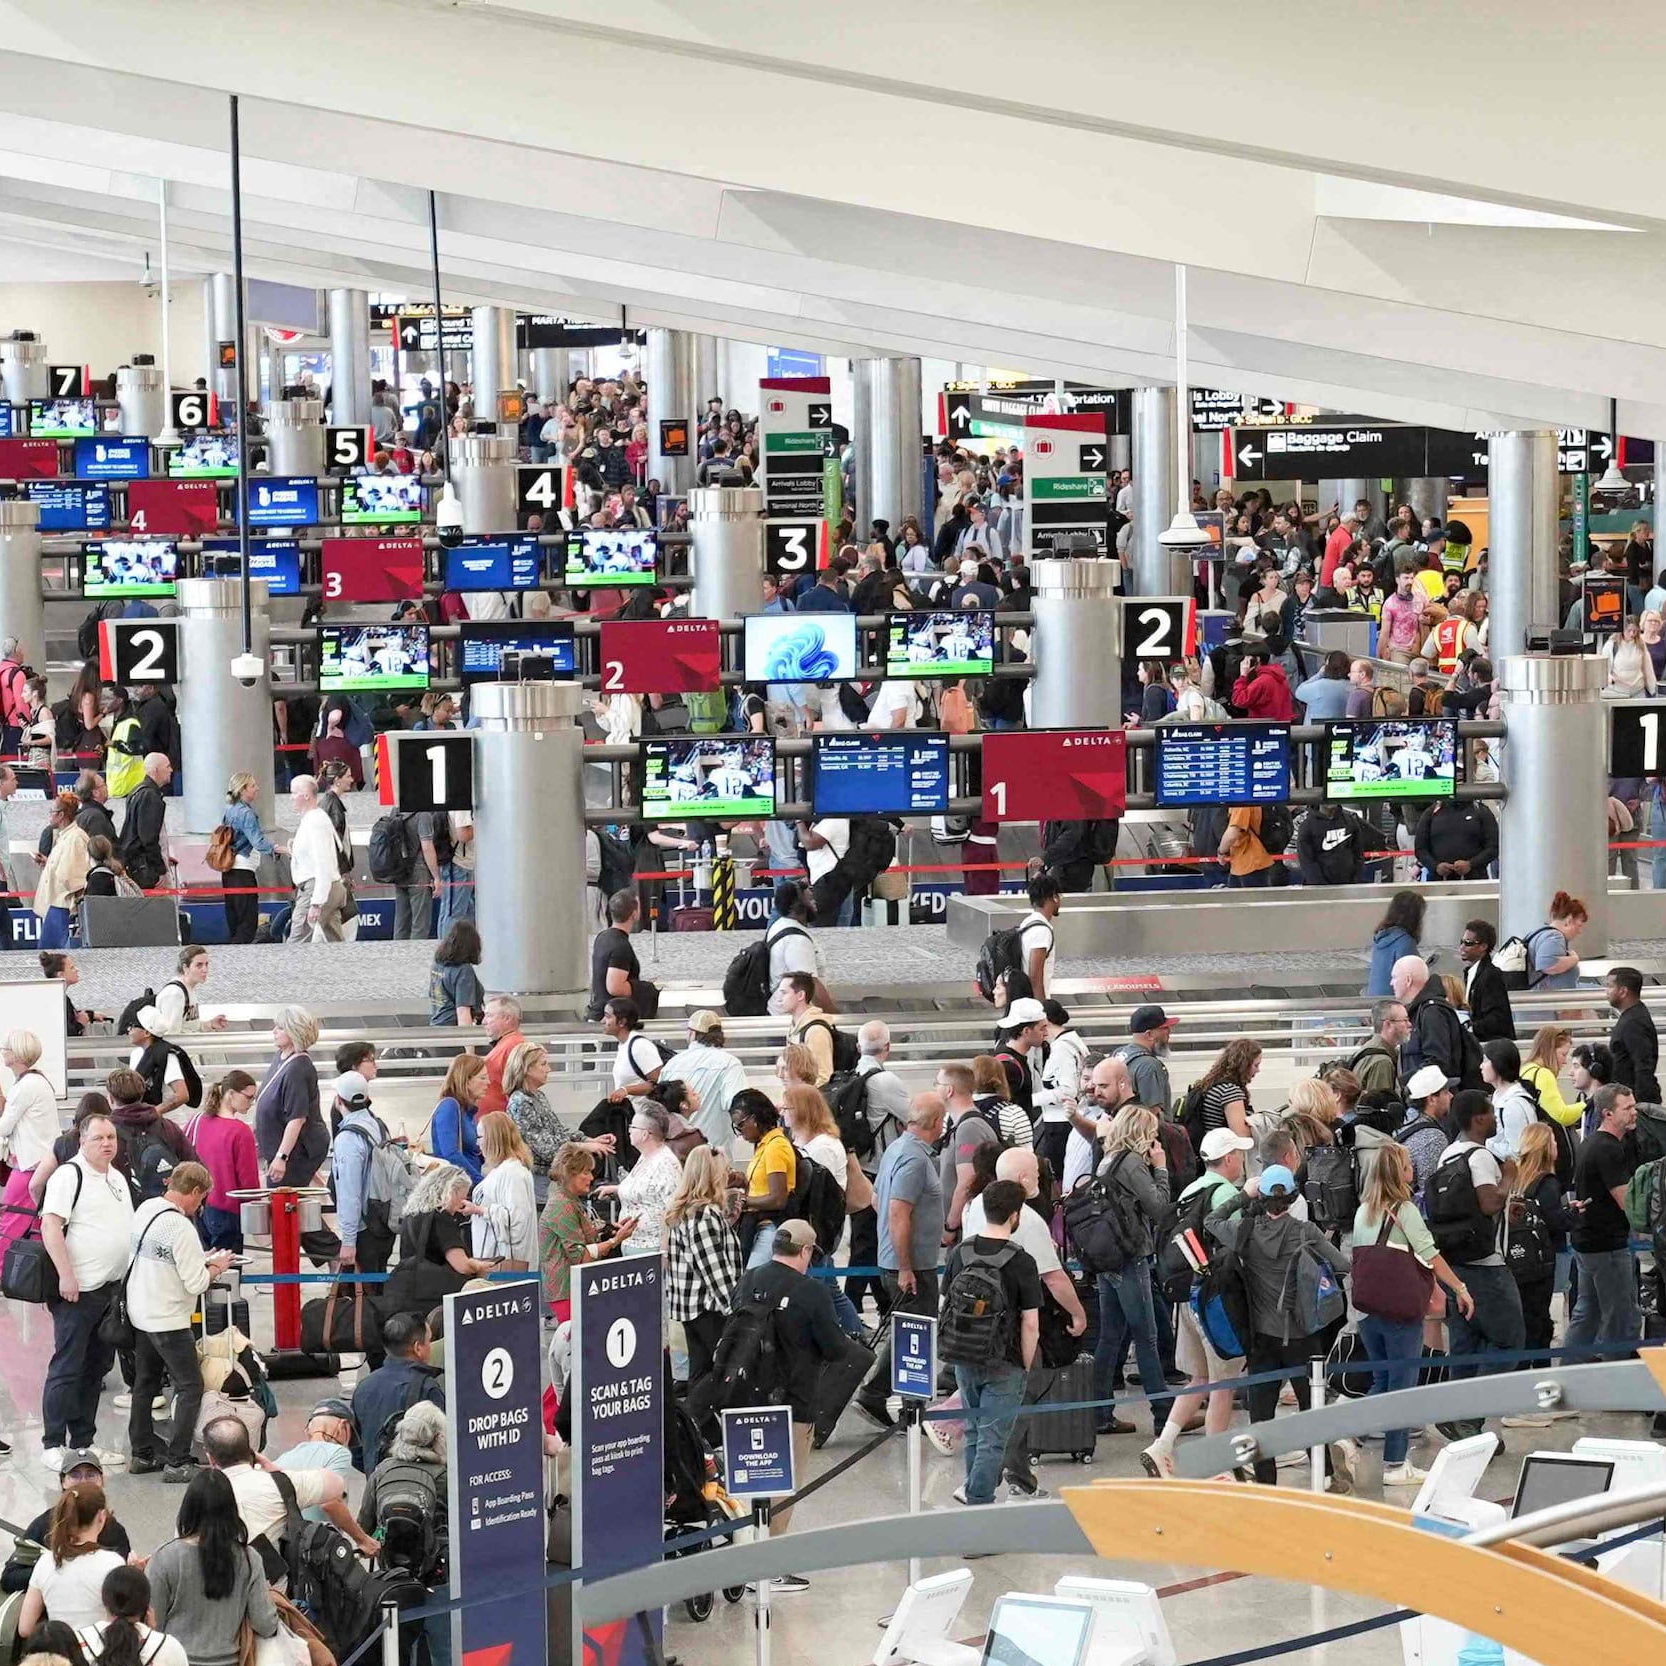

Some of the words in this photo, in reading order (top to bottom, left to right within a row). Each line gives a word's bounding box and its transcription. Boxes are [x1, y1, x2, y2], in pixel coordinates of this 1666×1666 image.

[57, 369, 75, 395] 7
[180, 396, 202, 425] 6
[335, 432, 358, 463] 5
[1285, 433, 1342, 446] Baggage
[1345, 431, 1380, 444] Claim
[526, 473, 555, 508] 4
[1053, 482, 1087, 490] Rideshare
[130, 510, 147, 531] 4
[778, 529, 807, 569] 3
[325, 573, 341, 598] 3
[1137, 609, 1170, 656] 2
[130, 630, 165, 679] 2
[604, 661, 625, 690] 2
[819, 737, 825, 747] 1
[1074, 737, 1111, 746] DELTA
[1162, 729, 1167, 738] 1
[1641, 714, 1658, 770] 1
[427, 746, 445, 803] 1
[1408, 757, 1424, 777] 12
[989, 781, 1007, 816] 1
[1108, 982, 1161, 990] CAROUSELS
[602, 1272, 643, 1292] DELTA
[476, 1301, 519, 1321] DELTA
[906, 1321, 923, 1329] DELTA
[617, 1328, 624, 1357] 1
[492, 1358, 503, 1388] 2
[591, 1383, 619, 1402] SCAN
[619, 1381, 627, 1397] &
[628, 1376, 652, 1394] TAG
[592, 1401, 622, 1420] YOUR
[623, 1394, 651, 1414] BAGS
[469, 1412, 499, 1433] DROP
[500, 1407, 529, 1426] BAGS
[743, 1416, 770, 1424] DELTA
[477, 1429, 507, 1450] WITH
[508, 1427, 521, 1444] ID
[592, 1443, 603, 1453] Scan
[604, 1441, 616, 1452] your
[617, 1439, 626, 1450] app
[627, 1433, 651, 1448] boarding
[592, 1455, 603, 1466] pass
[604, 1453, 609, 1462] at
[610, 1449, 623, 1460] kiosk
[624, 1448, 630, 1457] to
[631, 1446, 644, 1458] print
[738, 1452, 779, 1461] DOWNLOAD
[745, 1459, 758, 1467] THE
[758, 1459, 773, 1467] APP
[470, 1473, 483, 1486] FOR
[483, 1469, 512, 1484] ACCESS:
[592, 1466, 602, 1477] bag
[485, 1499, 496, 1510] App
[497, 1493, 520, 1508] Boarding
[521, 1490, 534, 1500] Pass
[485, 1512, 520, 1527] Identification
[520, 1508, 537, 1521] Ready
